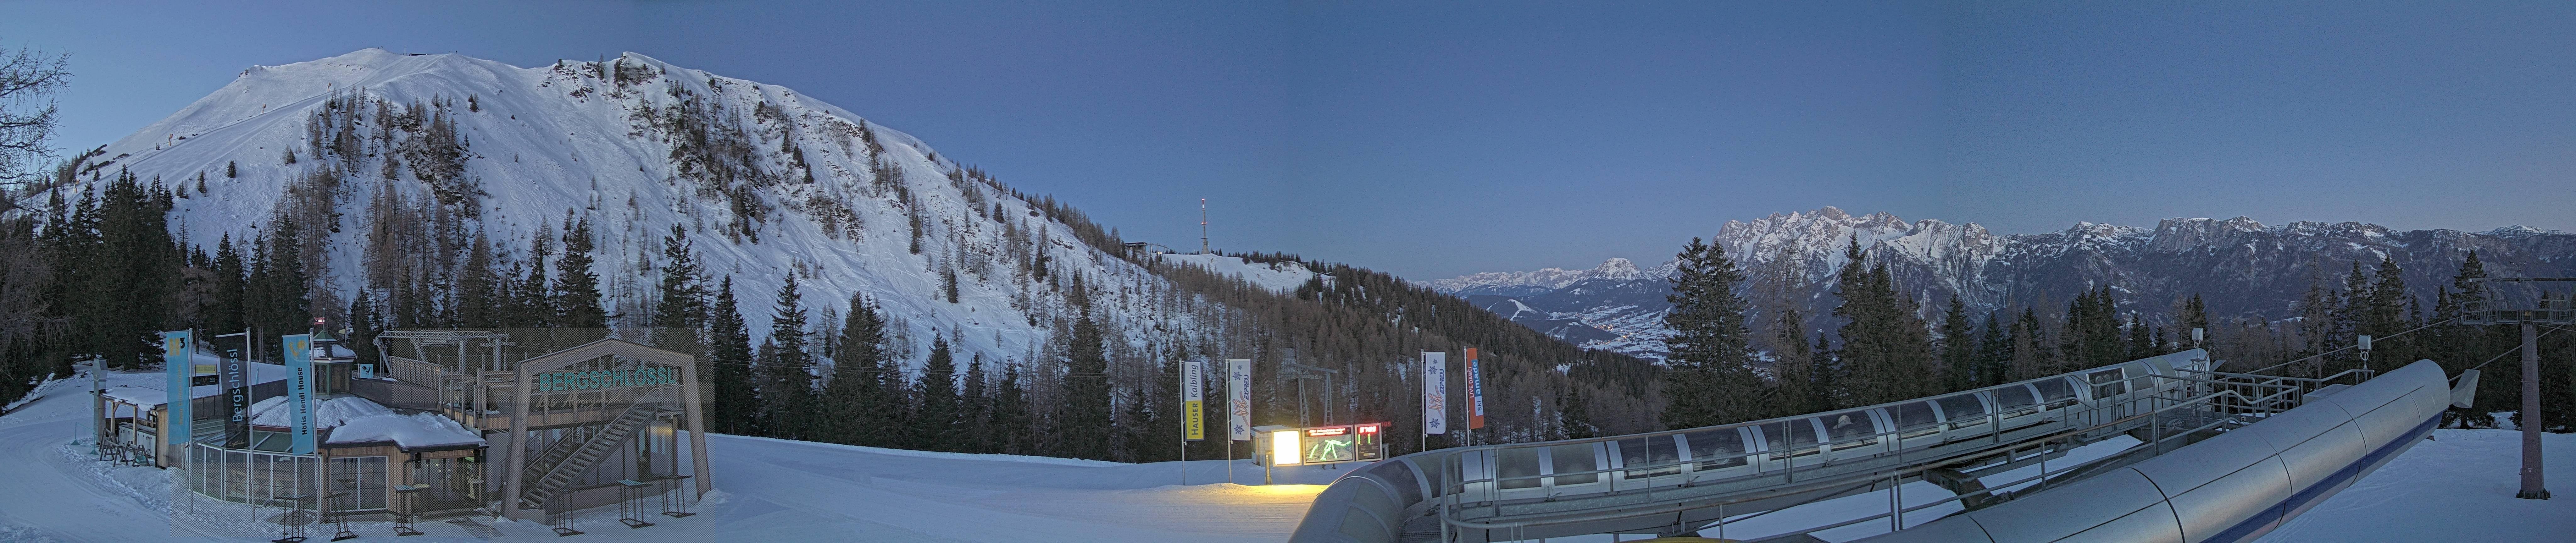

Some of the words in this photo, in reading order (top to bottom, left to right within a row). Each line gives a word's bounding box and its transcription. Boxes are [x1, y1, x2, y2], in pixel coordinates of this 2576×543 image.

[227, 349, 244, 422] Bergschlössl
[539, 366, 676, 391] BERGSCHLÖSSL
[1190, 365, 1198, 398] Kaibling
